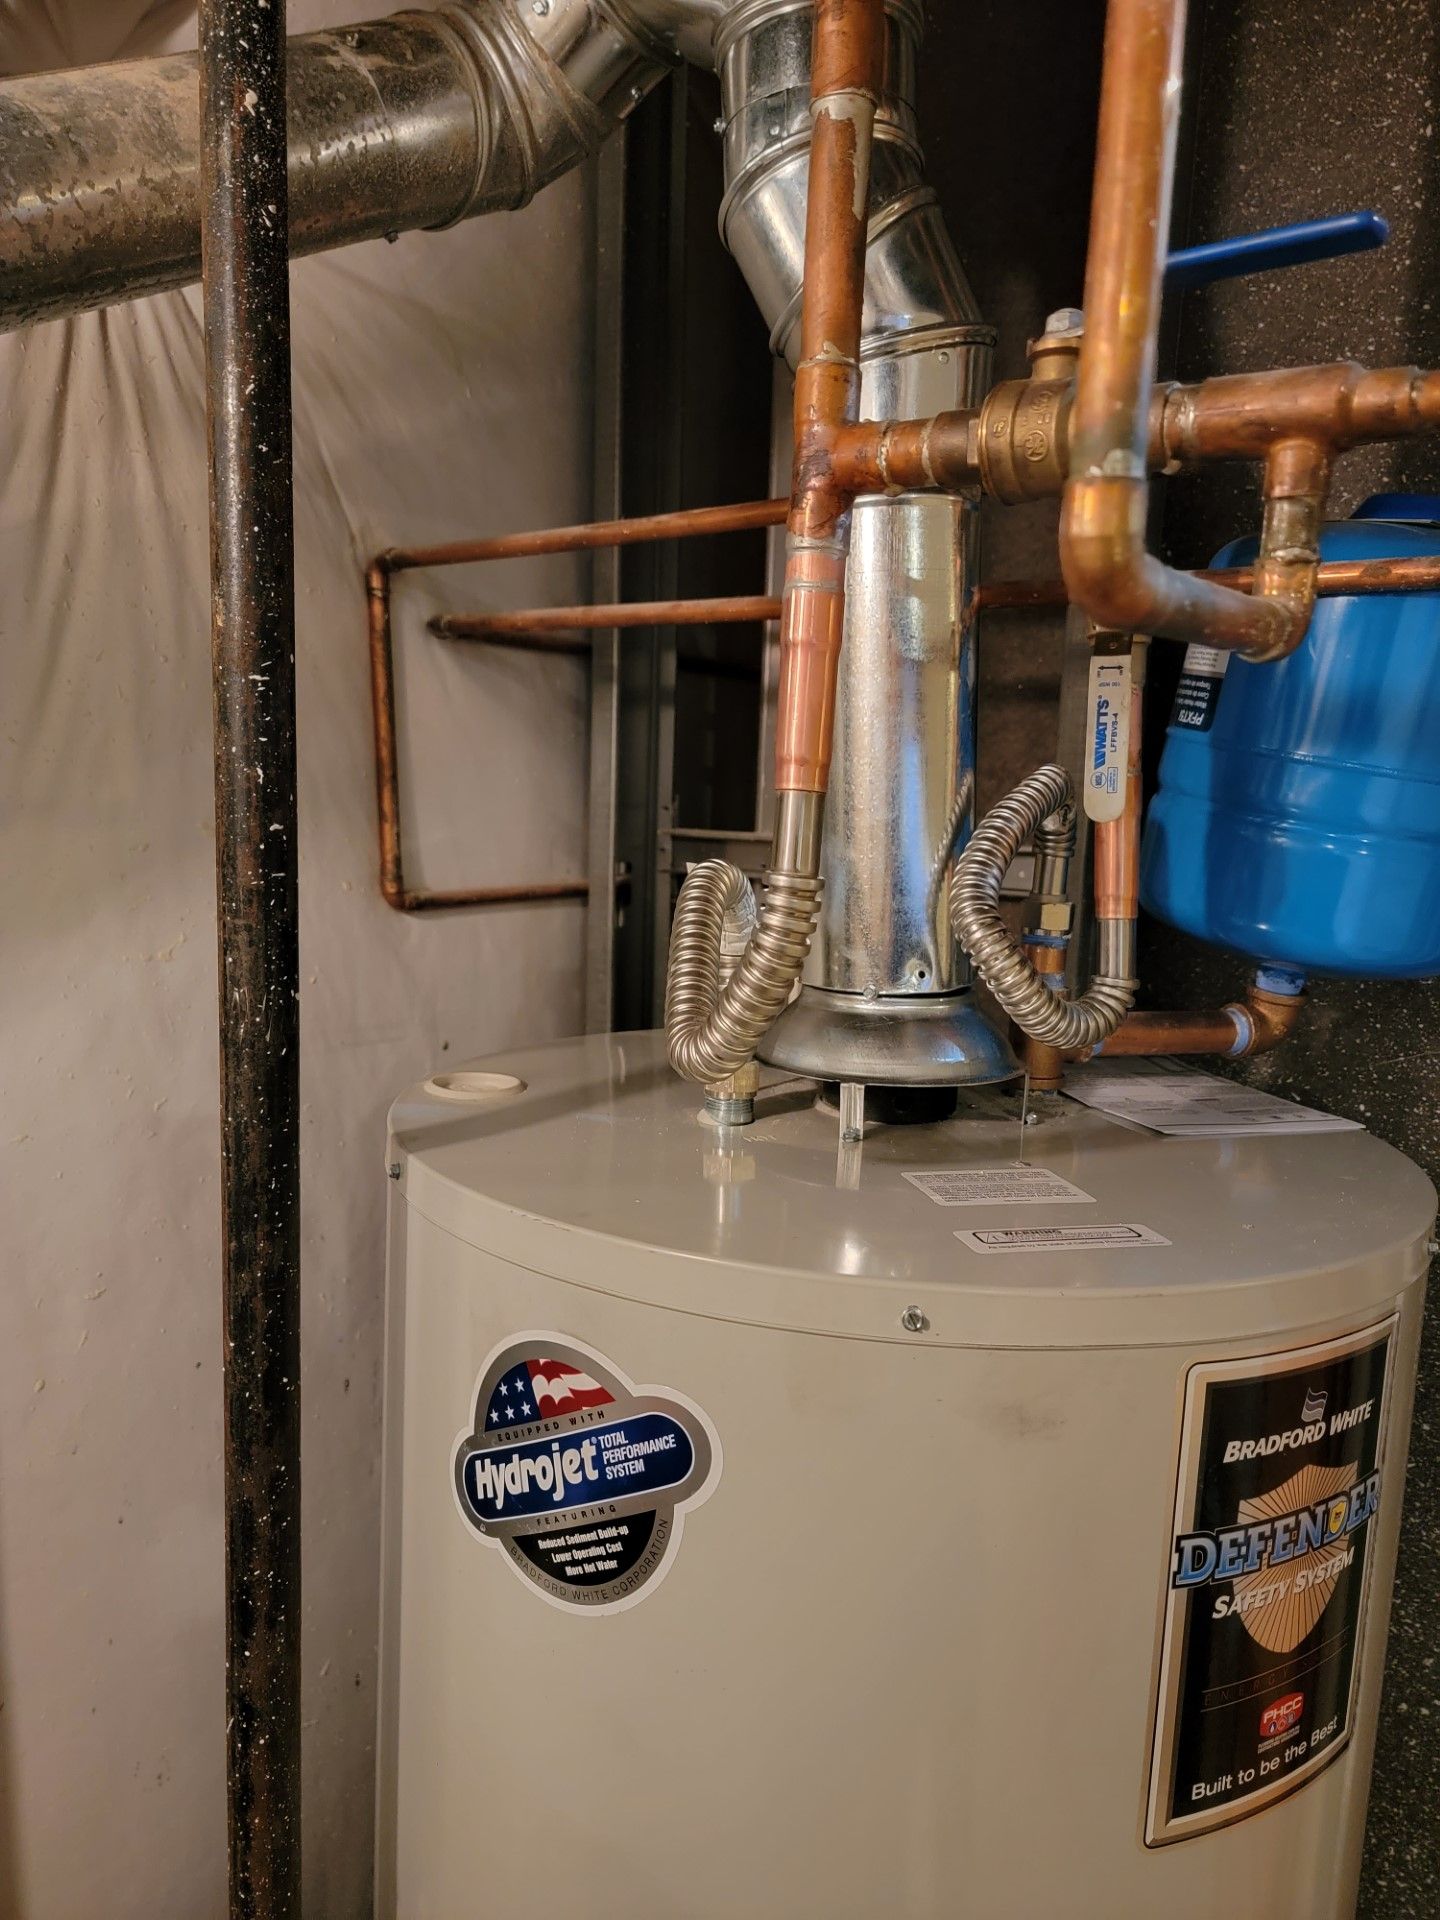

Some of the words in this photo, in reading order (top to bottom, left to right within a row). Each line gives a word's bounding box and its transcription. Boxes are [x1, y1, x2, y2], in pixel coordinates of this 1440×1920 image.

[1094, 699, 1109, 770] WATTS
[1110, 712, 1119, 753] LFFBVS-4
[497, 1421, 560, 1442] EQUIPPED
[569, 1410, 606, 1426] WITH
[1222, 1421, 1326, 1464] BRADFORD
[1329, 1399, 1374, 1436] WHITE
[602, 1434, 677, 1465] PERFORMANCE
[475, 1439, 599, 1510] Hydrojet
[598, 1430, 629, 1449] TOTAL
[605, 1458, 646, 1480] SYSTEM
[536, 1504, 617, 1526] FEATURING
[1174, 1469, 1380, 1587] DEFENDER
[537, 1536, 566, 1550] Reduced
[566, 1530, 598, 1545] Sediment
[598, 1524, 630, 1540] Build-up
[551, 1550, 573, 1564] Lower
[573, 1545, 606, 1561] Operating
[607, 1541, 624, 1553] Cost
[510, 1546, 567, 1596] BRADFORD
[571, 1589, 610, 1601] WHITE
[612, 1519, 669, 1595] CORPORATION
[565, 1565, 584, 1577] More
[584, 1562, 597, 1574] Hot
[597, 1558, 619, 1571] Water
[1212, 1577, 1294, 1619] SAFETY
[1293, 1546, 1355, 1594] SYSTEM
[1263, 1696, 1303, 1724] PHCC
[1191, 1774, 1233, 1801] Built
[1237, 1768, 1255, 1785] to
[1260, 1756, 1280, 1777] be
[1284, 1740, 1307, 1763] the
[1310, 1715, 1338, 1748] Best
